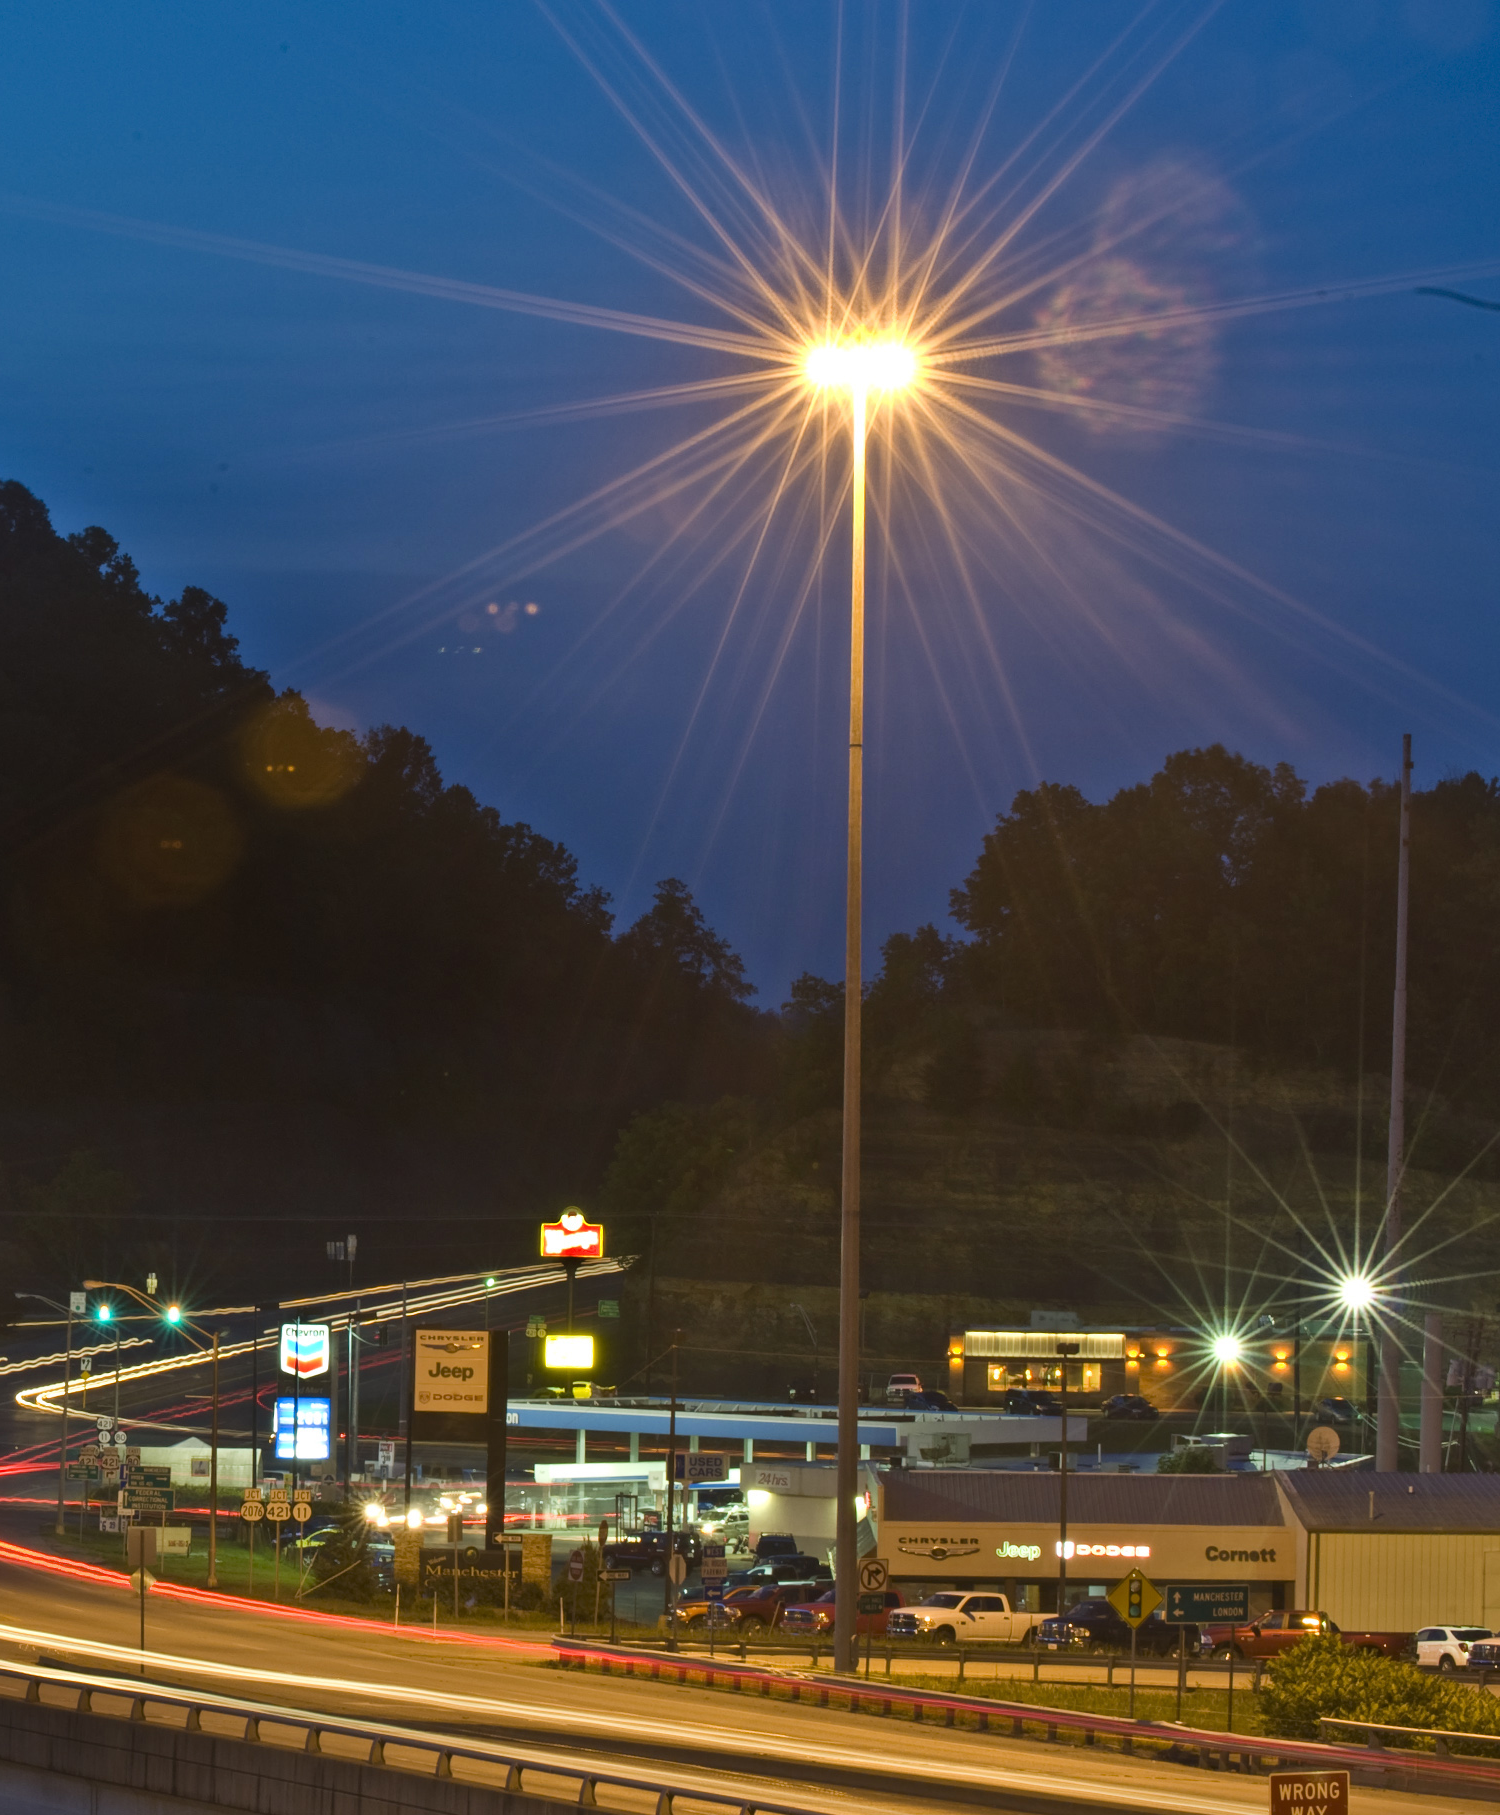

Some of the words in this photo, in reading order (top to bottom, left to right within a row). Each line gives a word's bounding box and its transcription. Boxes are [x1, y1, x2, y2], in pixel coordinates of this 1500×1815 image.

[286, 1327, 325, 1336] Chevron
[428, 1362, 474, 1382] Jeep
[432, 1394, 484, 1402] DODGE
[98, 1418, 112, 1428] 421
[116, 1433, 126, 1442] 80
[102, 1458, 118, 1467] 421
[689, 1457, 722, 1467] USED
[688, 1467, 722, 1478] CARS
[758, 1472, 772, 1485] 24
[246, 1490, 260, 1498] JCT
[272, 1492, 286, 1500] JCT
[296, 1492, 310, 1500] JCT
[128, 1496, 168, 1504] CORRECTIONAL
[242, 1506, 263, 1517] 2076
[268, 1506, 288, 1518] 421
[297, 1508, 307, 1518] 11
[996, 1541, 1041, 1561] Jeep
[1076, 1544, 1151, 1558] DODGE
[1205, 1546, 1276, 1562] Cornett
[426, 1565, 519, 1578] Manchester
[1194, 1592, 1244, 1602] MANCHESTER
[1212, 1606, 1244, 1618] LONDON
[1279, 1782, 1340, 1801] WRONG
[1291, 1804, 1328, 1815] WAY
